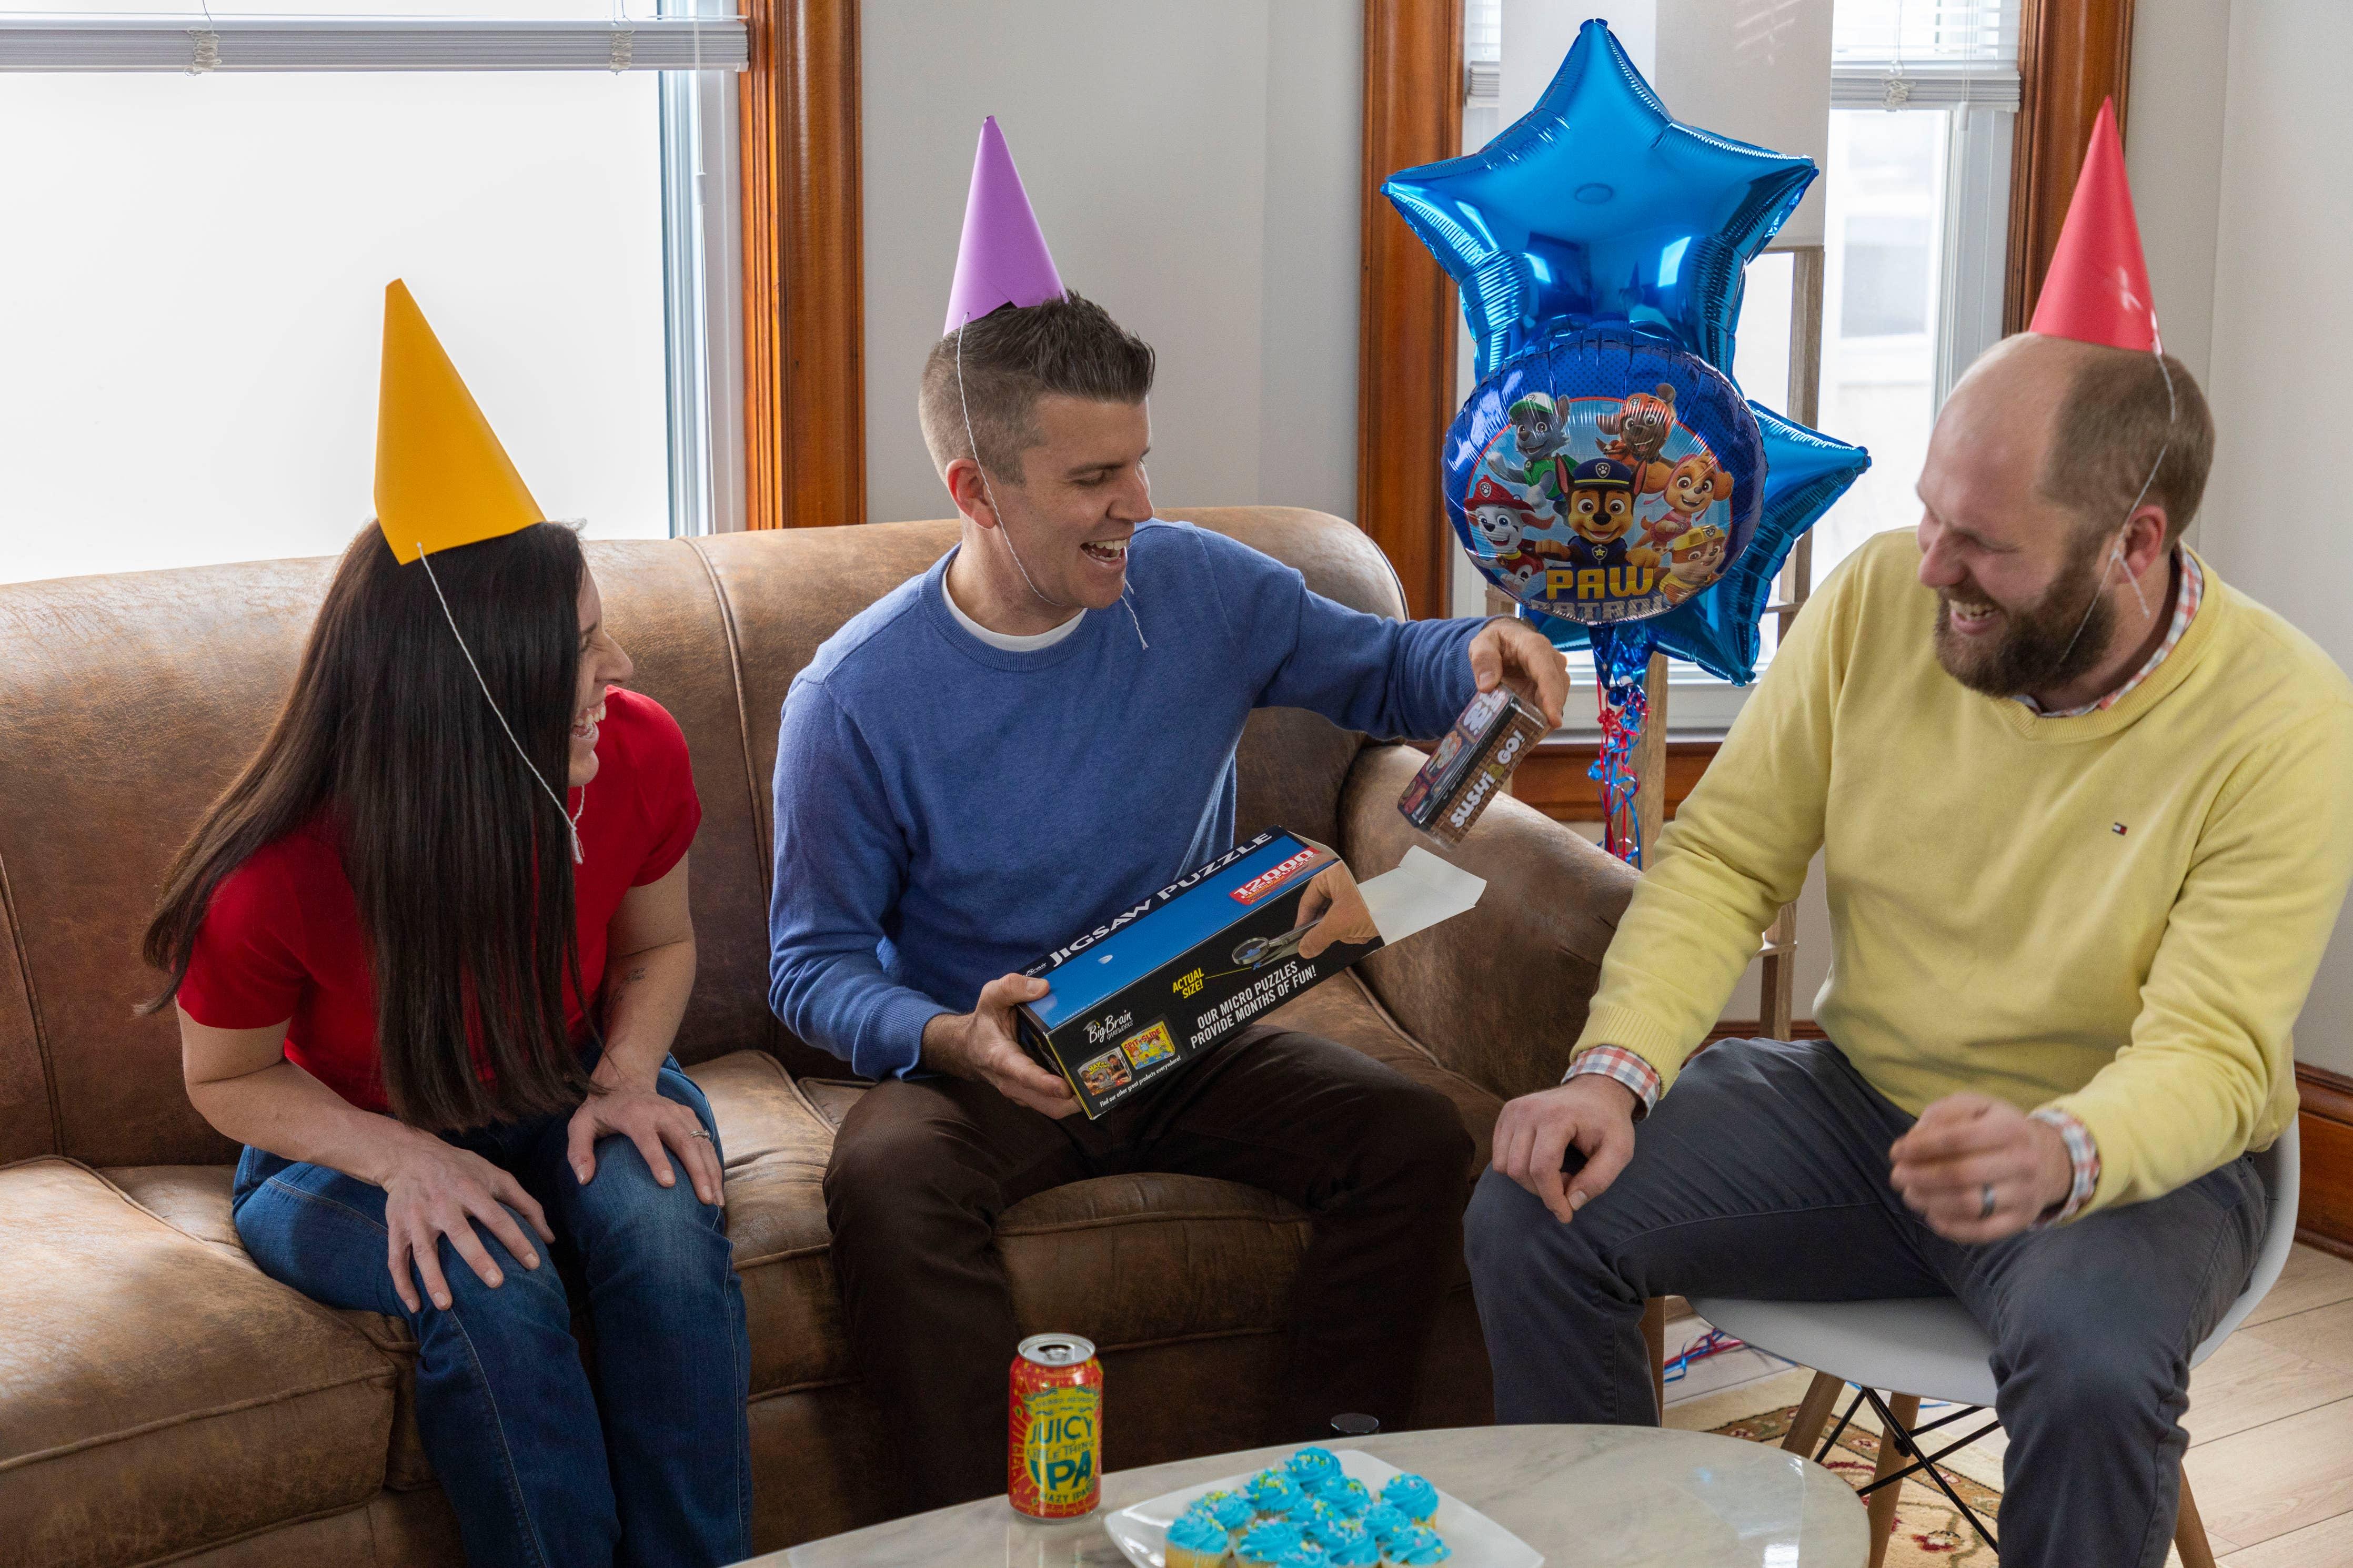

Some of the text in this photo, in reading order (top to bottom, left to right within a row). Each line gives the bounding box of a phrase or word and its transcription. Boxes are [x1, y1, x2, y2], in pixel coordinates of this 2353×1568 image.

[1546, 566, 1654, 600] PAW
[1233, 849, 1314, 895] 12000
[1050, 833, 1272, 967] JIGSAW PUZZLE
[1172, 967, 1204, 994] ACTUAL
[1182, 980, 1204, 999] SIZE!
[1197, 960, 1298, 1029] OUR MICRO PUZZLES
[1190, 964, 1317, 1049] PROVIDE MONTHS OF FUN!
[1107, 1019, 1133, 1041] GAMEWORKS
[1124, 1038, 1138, 1050] SPIT
[1141, 1028, 1162, 1043] SLIDE
[1100, 1097, 1109, 1108] Find
[1117, 1088, 1128, 1098] other
[1128, 1080, 1139, 1092] great
[1139, 1070, 1157, 1086] products
[1156, 1055, 1182, 1075] everywhere!
[1029, 1416, 1092, 1444] JUICY
[1029, 1450, 1092, 1491] IPA
